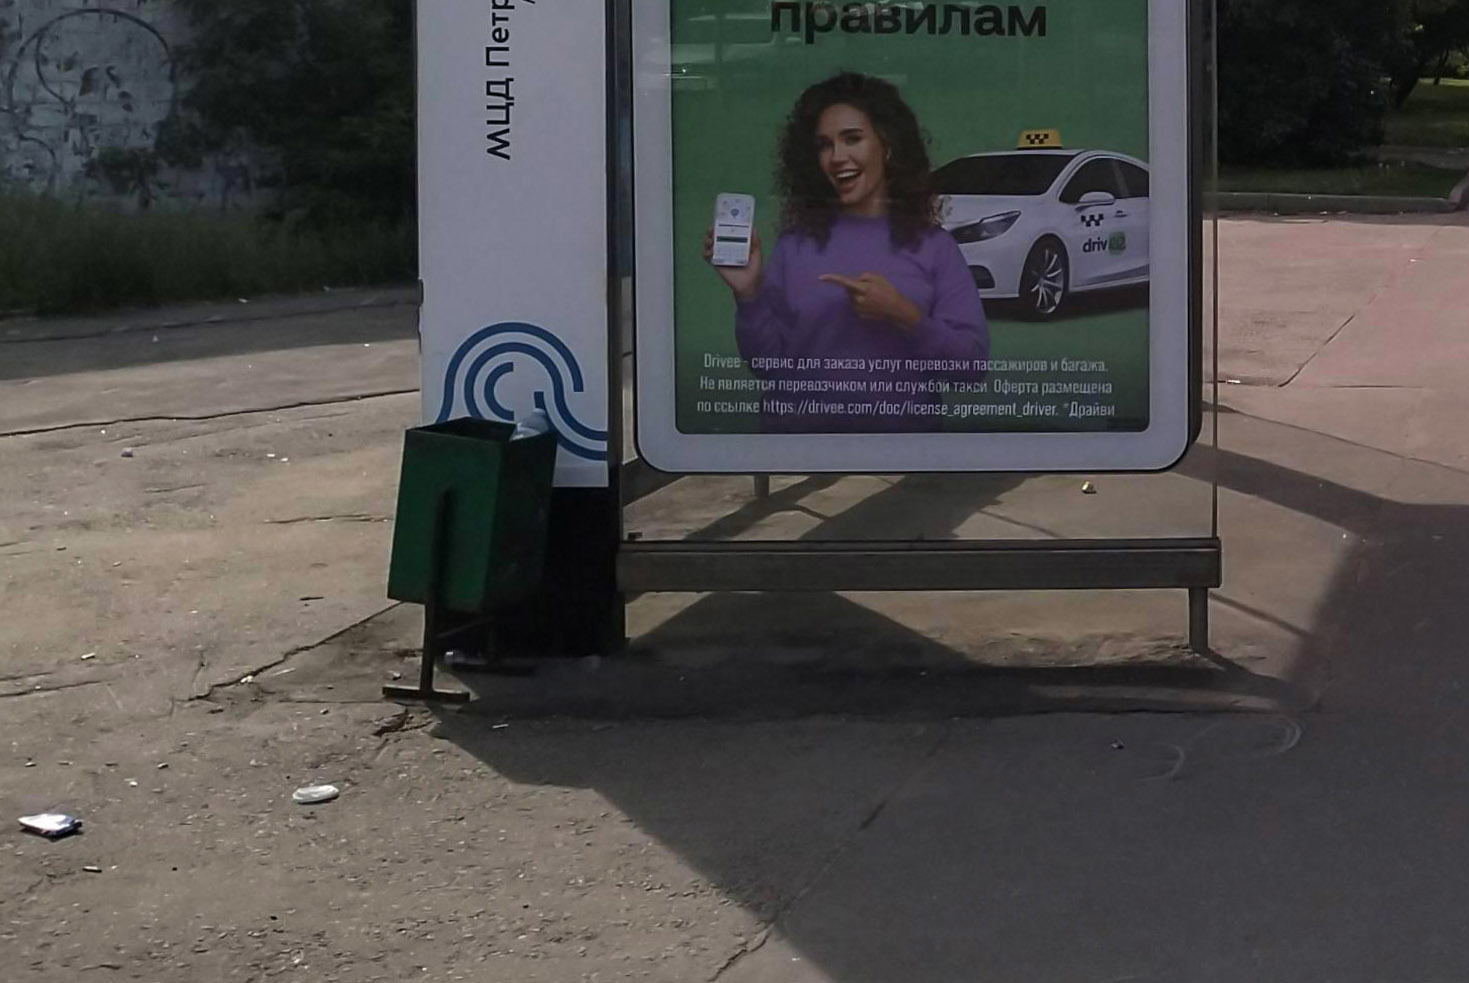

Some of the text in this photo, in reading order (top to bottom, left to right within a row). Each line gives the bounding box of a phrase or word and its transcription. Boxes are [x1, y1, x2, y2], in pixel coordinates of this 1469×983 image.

[770, 0, 1047, 43] правилам
[486, 78, 514, 160] МЦД
[704, 353, 740, 368] Drivee
[751, 357, 793, 371] сервис
[797, 357, 820, 370] для
[824, 357, 865, 370] заказа
[868, 358, 901, 373] услуг
[905, 359, 970, 373] перевозки
[973, 359, 1047, 373] пассажиров
[1050, 360, 1058, 371] и
[700, 376, 714, 390] Не
[718, 378, 775, 391] является
[778, 379, 867, 393] перевозчиком
[869, 380, 892, 392] или
[895, 378, 950, 394] службой
[993, 379, 1039, 395] Оферта
[1041, 382, 1113, 396] размещена
[697, 401, 711, 413] по
[714, 401, 760, 413] ссылке
